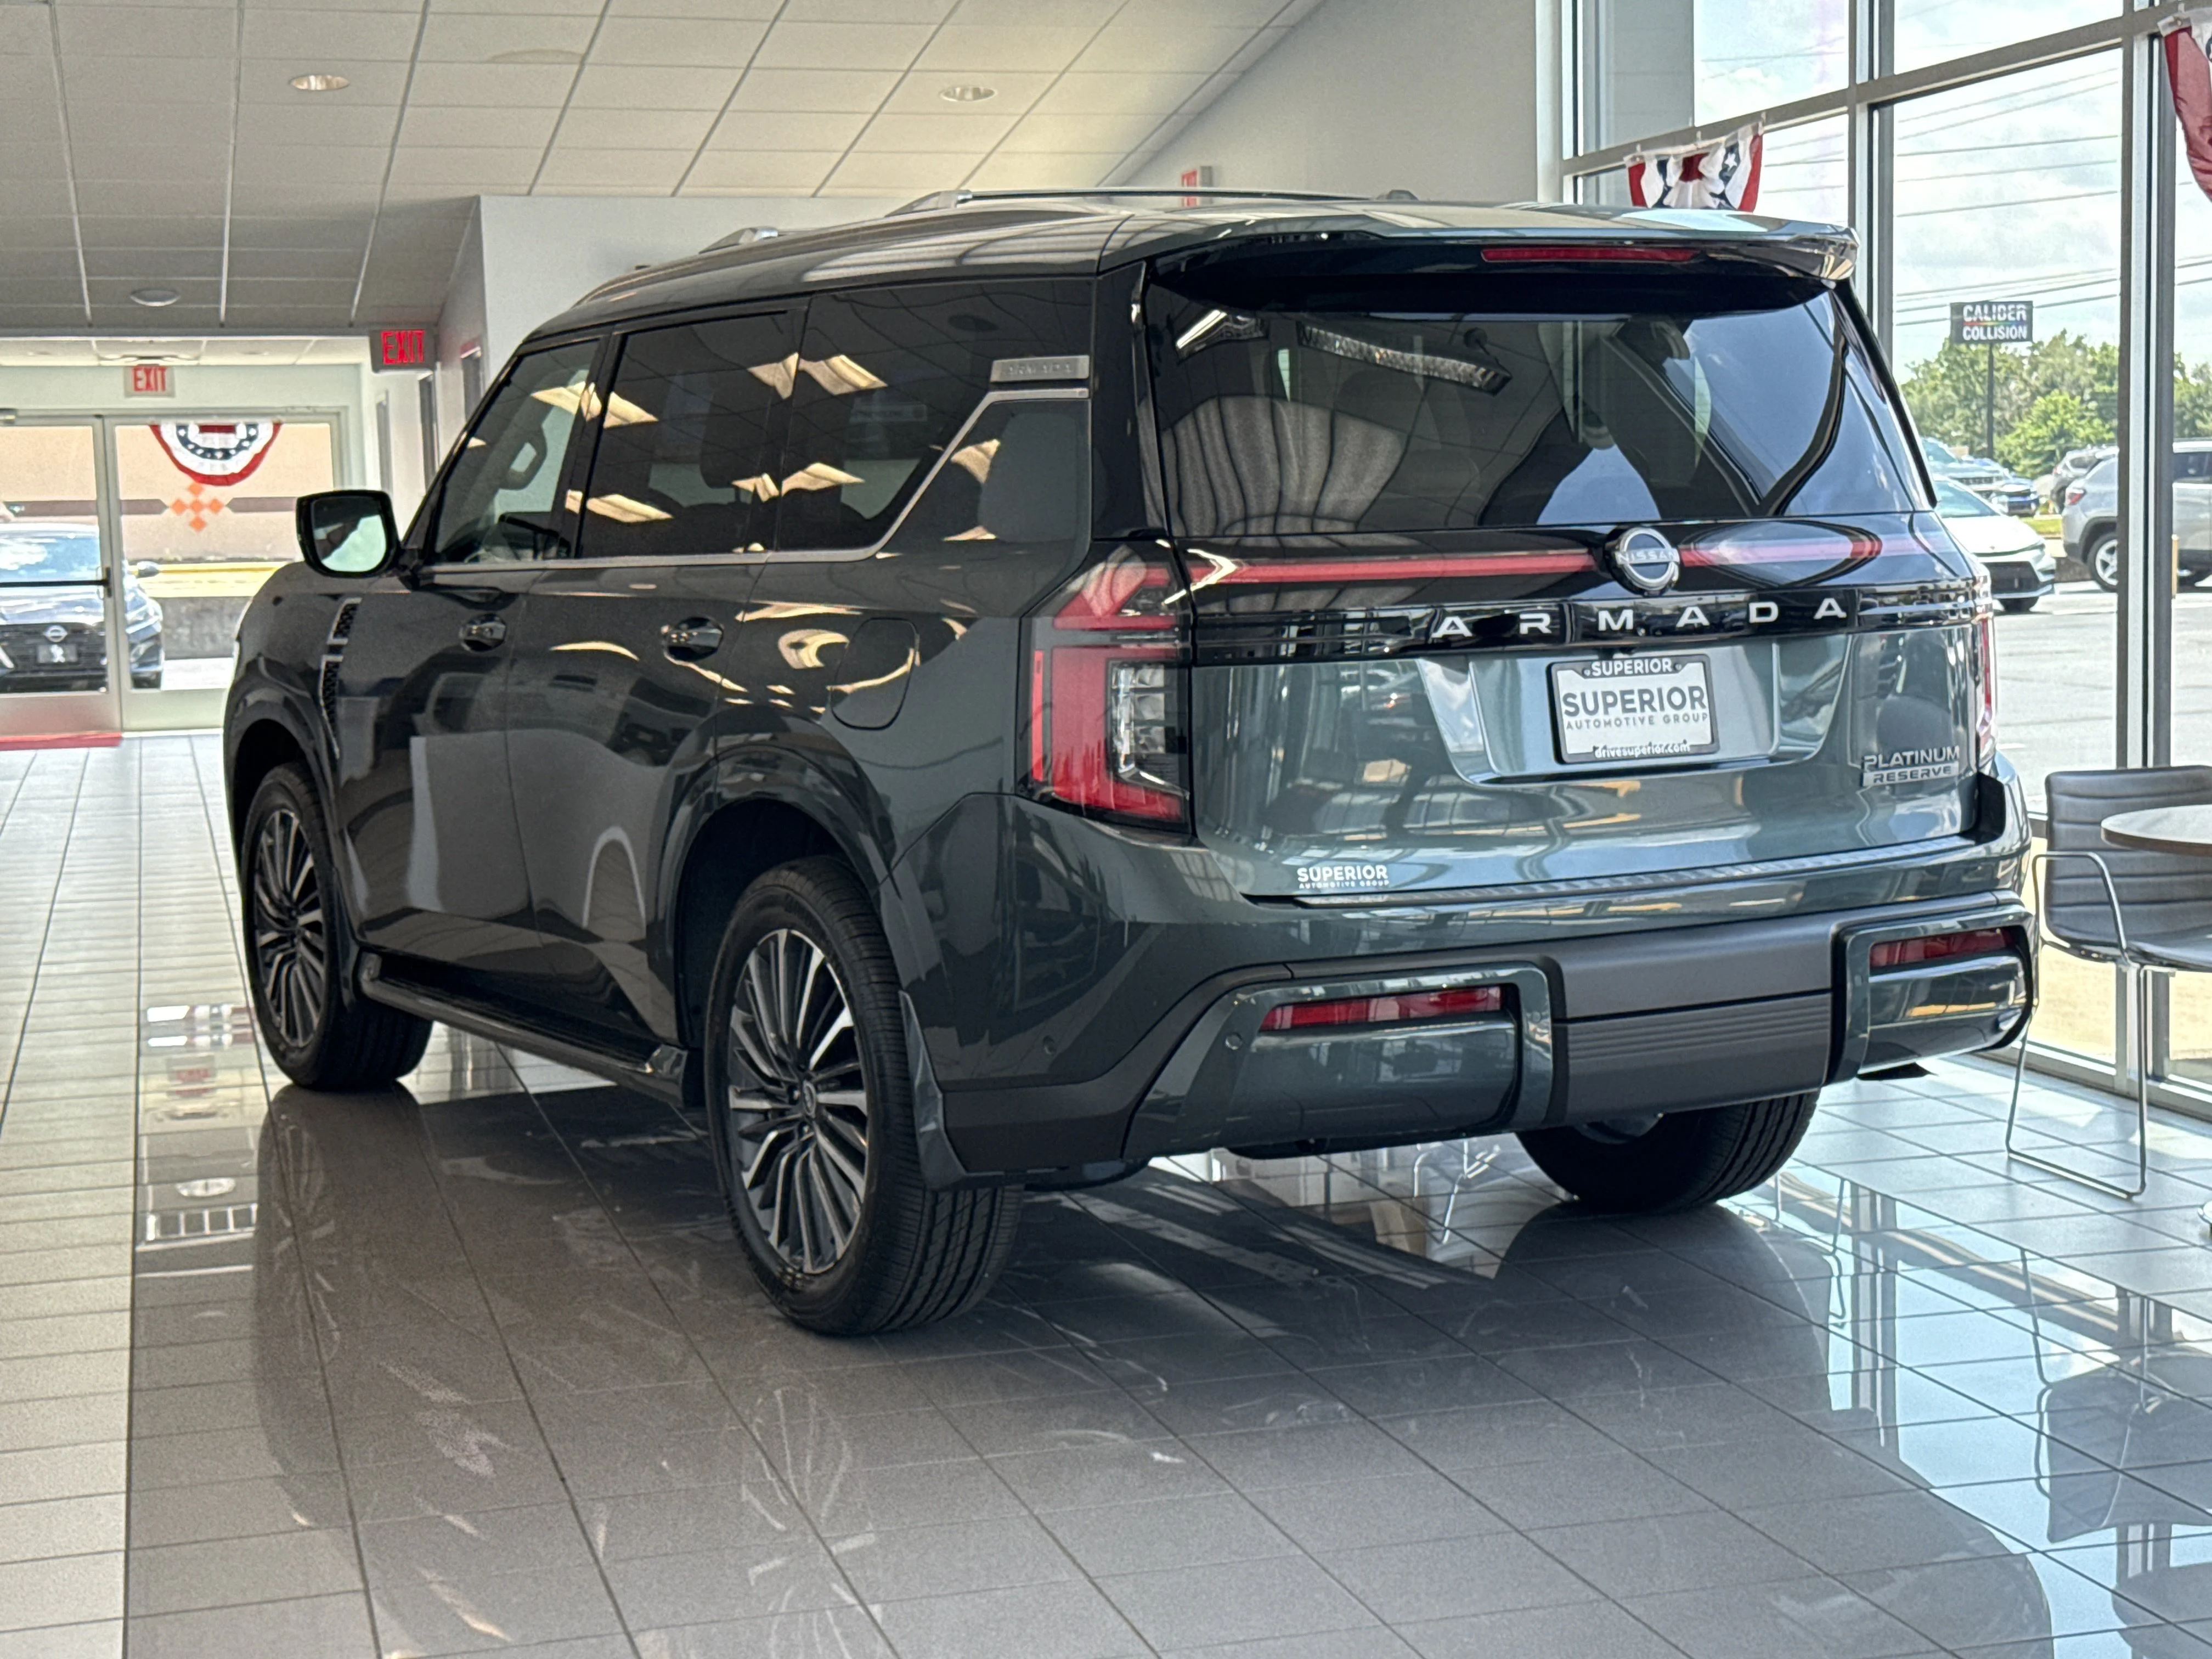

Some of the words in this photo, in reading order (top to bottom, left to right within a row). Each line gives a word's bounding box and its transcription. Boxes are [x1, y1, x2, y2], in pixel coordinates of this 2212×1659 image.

[1962, 325, 2028, 341] COLLISION
[381, 329, 426, 365] EXIT
[133, 366, 167, 392] EXIT
[1619, 550, 1674, 562] NISSAN
[1432, 597, 1847, 638] ARMADA
[1591, 658, 1673, 676] SUPERIOR
[1562, 685, 1707, 717] SUPERIOR
[1566, 715, 1655, 730] AUTOMOTIVE
[1663, 713, 1708, 725] GROUP
[1594, 742, 1691, 758] drivesuperior.com
[1864, 746, 1960, 771] PLATINUM
[1873, 765, 1952, 783] RESERVE
[1297, 865, 1388, 882] SUPERIOR
[1299, 881, 1356, 889] AUTOMOTIVE
